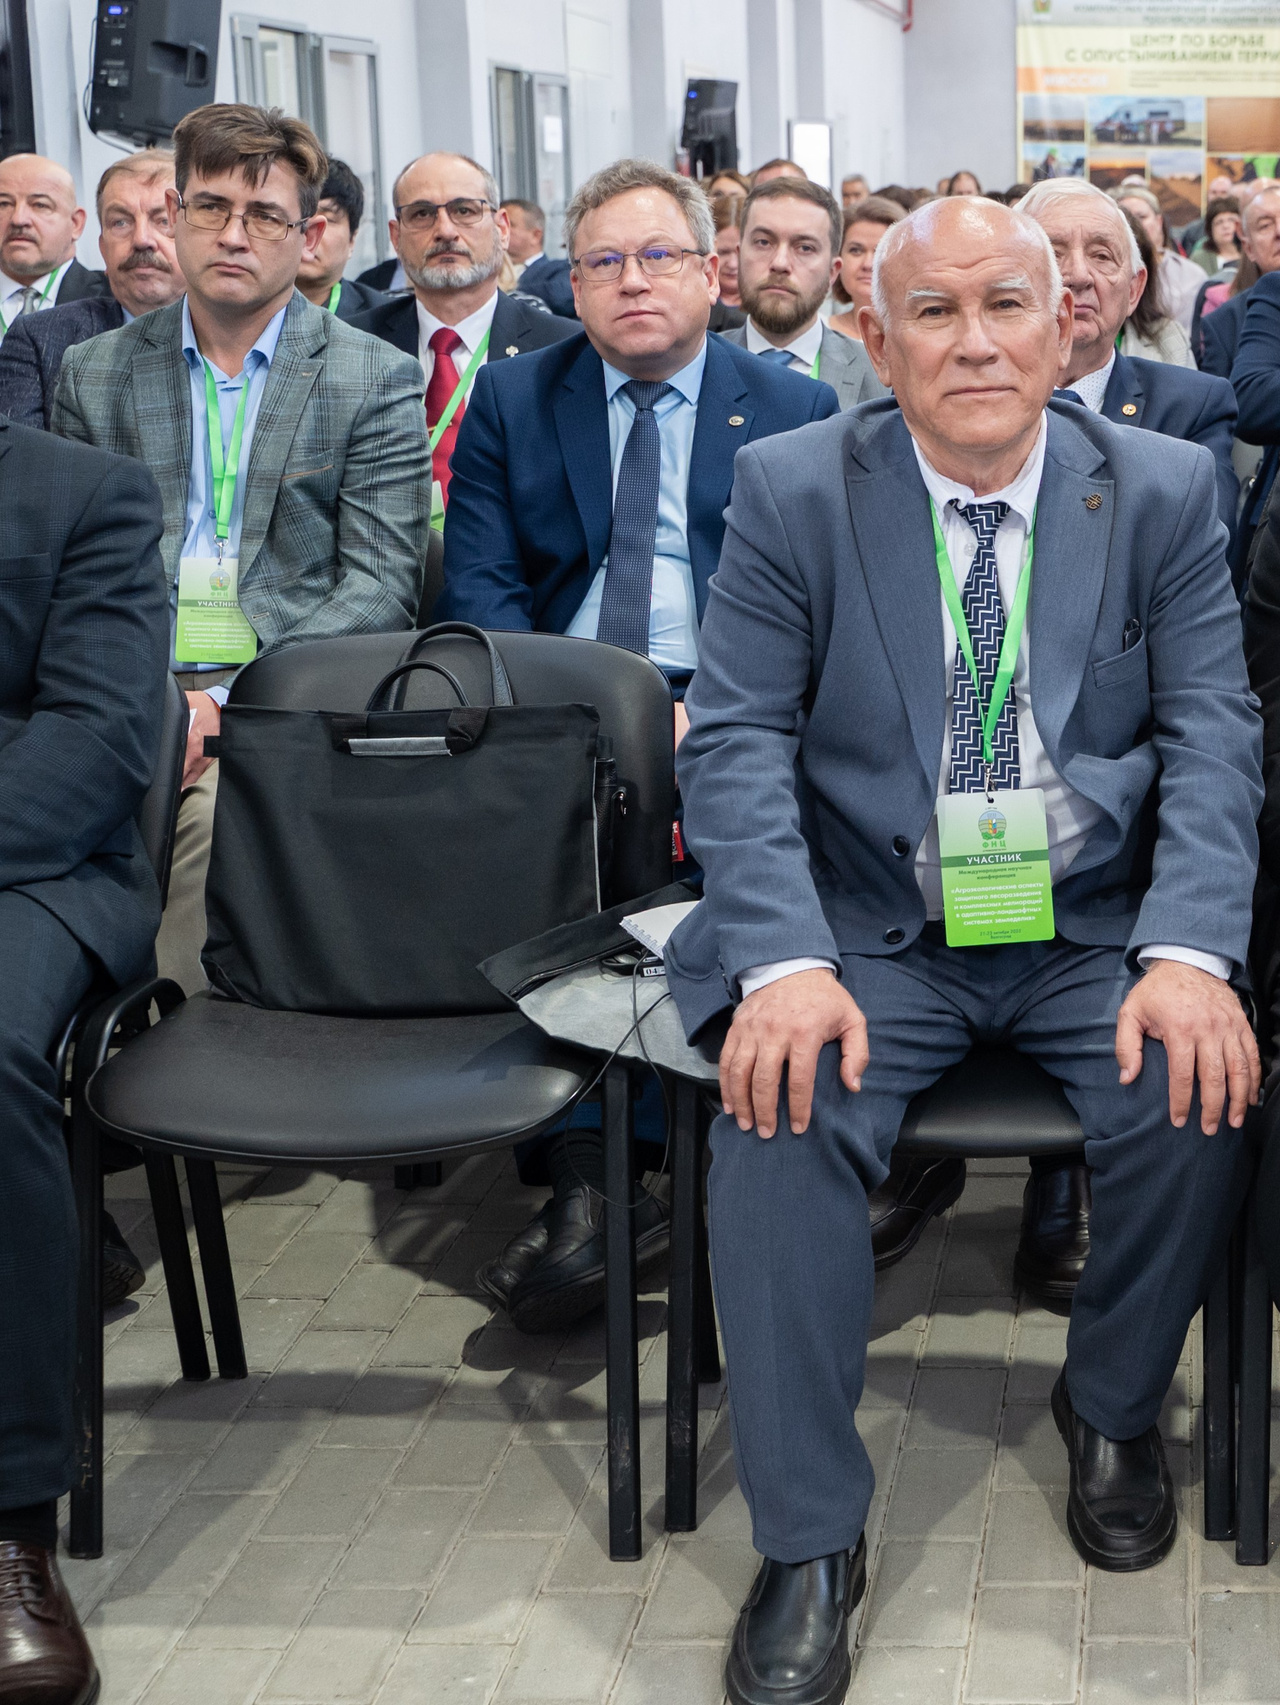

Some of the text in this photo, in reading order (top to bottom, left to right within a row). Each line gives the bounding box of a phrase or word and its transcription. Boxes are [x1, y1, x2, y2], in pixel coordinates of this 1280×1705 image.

[1130, 34, 1264, 47] ЦЕНТР ПО БОРЬБЕ
[1065, 49, 1077, 62] С
[1081, 49, 1232, 62] ОПУСТЫНИВАНИЕМ
[982, 840, 1006, 848] ФНЦ
[967, 853, 1021, 865] УЧАСТНИК
